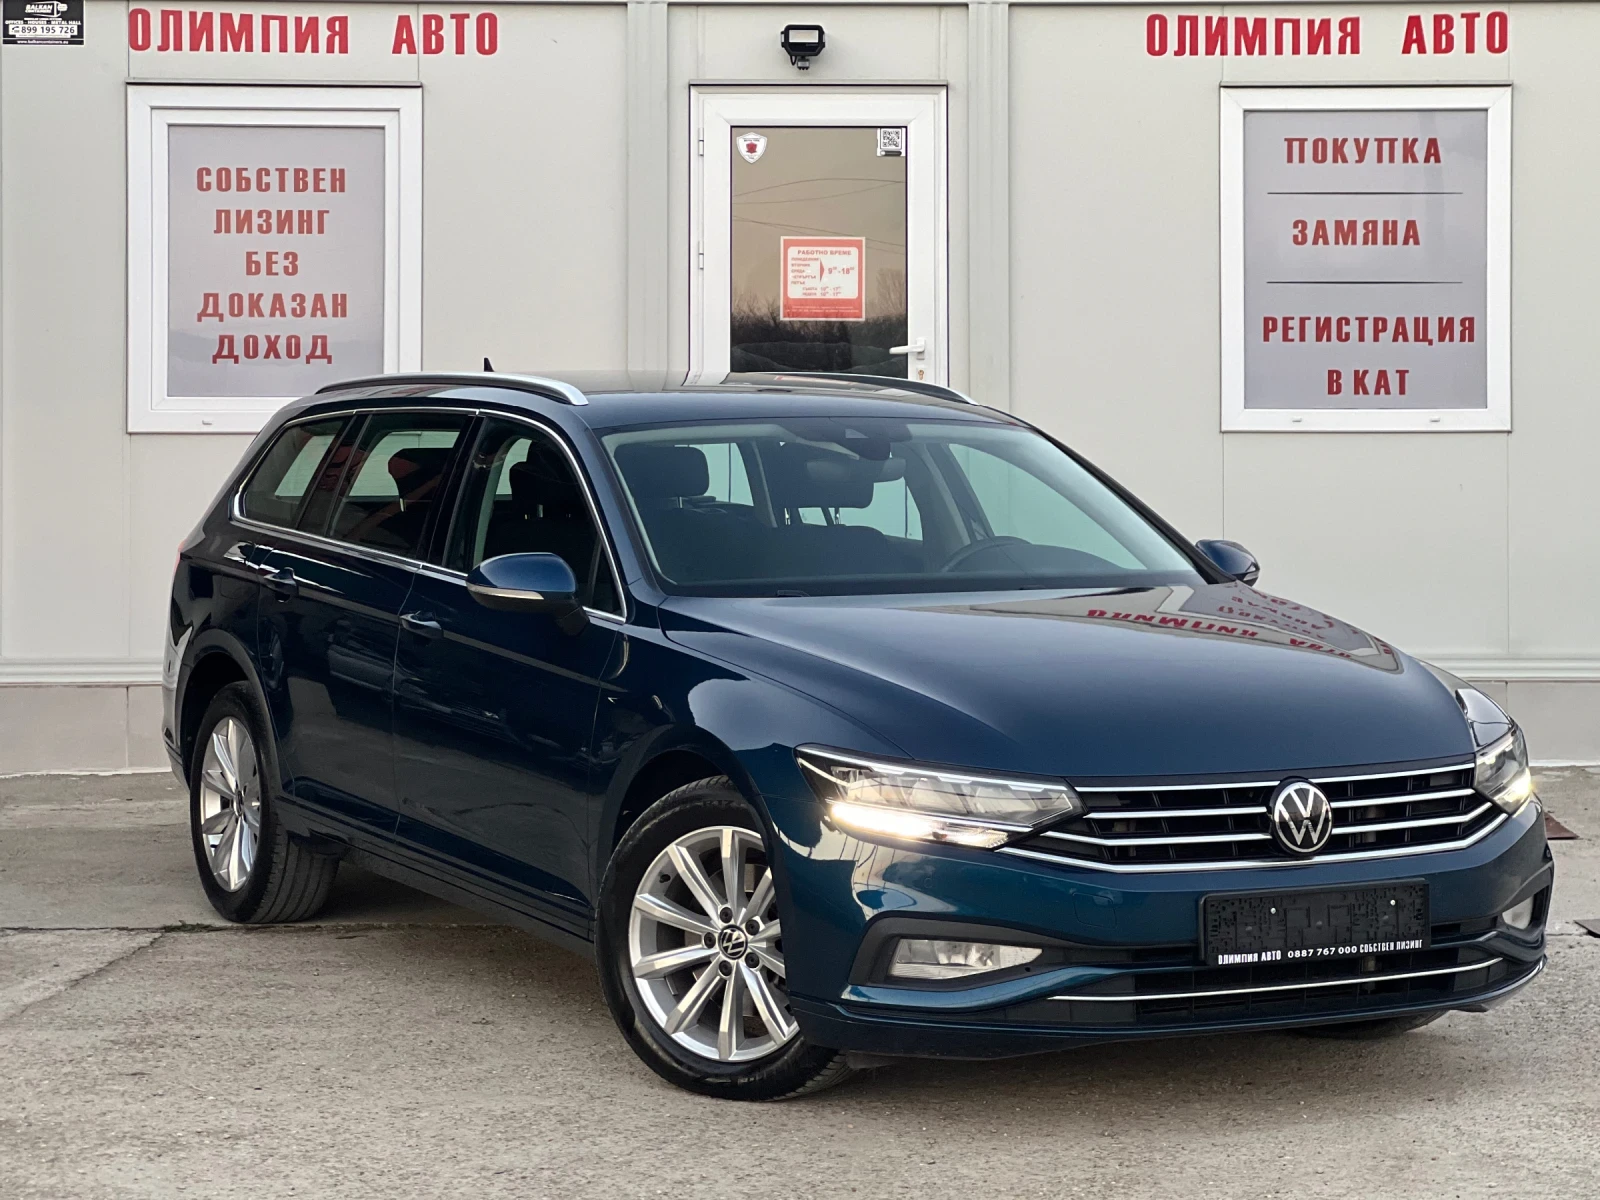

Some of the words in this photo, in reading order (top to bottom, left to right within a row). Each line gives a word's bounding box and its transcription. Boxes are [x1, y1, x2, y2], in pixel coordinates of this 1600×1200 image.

[21, 26, 38, 34] 899
[40, 26, 56, 34] 195
[59, 26, 75, 34] 726
[128, 8, 349, 55] ОЛИМПИЯ
[391, 12, 499, 56] АВТО
[1145, 13, 1361, 57] ОЛИМПИЯ
[1401, 11, 1509, 55] АВТО
[1285, 137, 1441, 164] ПОКУПКА
[196, 167, 346, 193] СОБСТВЕН
[214, 209, 330, 235] ЛИЗИНГ
[1292, 219, 1420, 246] ЗАМЯНА
[245, 251, 299, 277] БЕЗ
[197, 293, 348, 322] ДОКАЗАН
[1263, 316, 1476, 345] РЕГИСТРАЦИЯ
[212, 335, 333, 364] ДОХОД
[1327, 369, 1343, 396] В
[1353, 369, 1410, 396] КАТ
[1217, 952, 1259, 965] ОЛИМПИЯ
[1260, 949, 1282, 962] АВТО
[1287, 948, 1314, 959] 0887
[1316, 946, 1336, 957] 767
[1338, 945, 1358, 955] 000
[1359, 941, 1395, 954] СОБСТВЕН
[1396, 939, 1423, 951] ЛИЗИНГ
